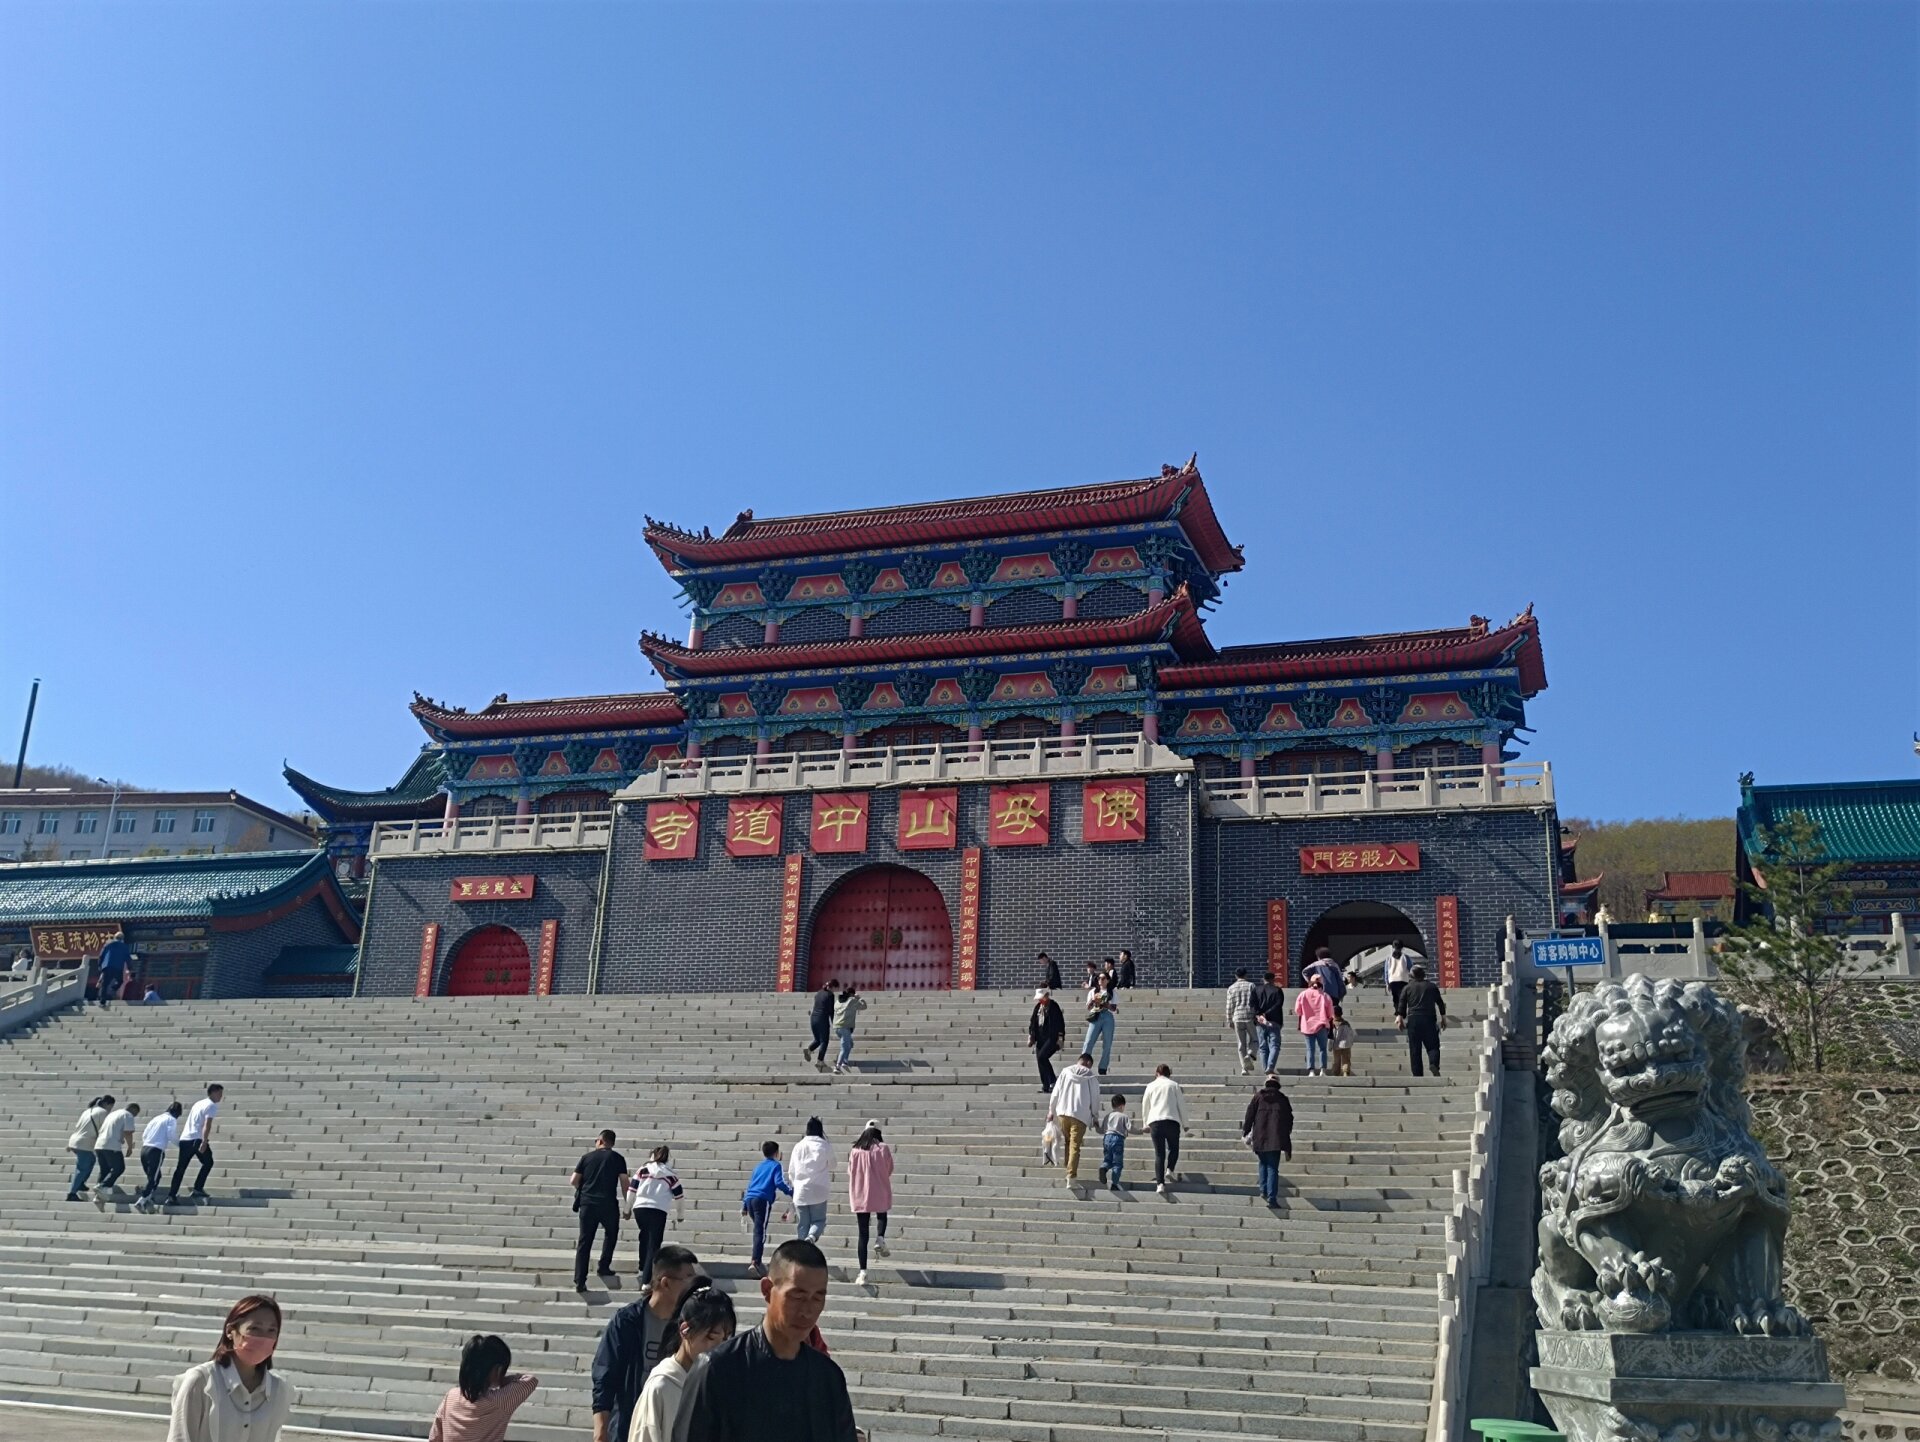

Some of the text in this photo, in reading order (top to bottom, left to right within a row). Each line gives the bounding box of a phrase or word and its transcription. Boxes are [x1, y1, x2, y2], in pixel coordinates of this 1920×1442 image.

[1537, 943, 1599, 962] 游客购物中心
